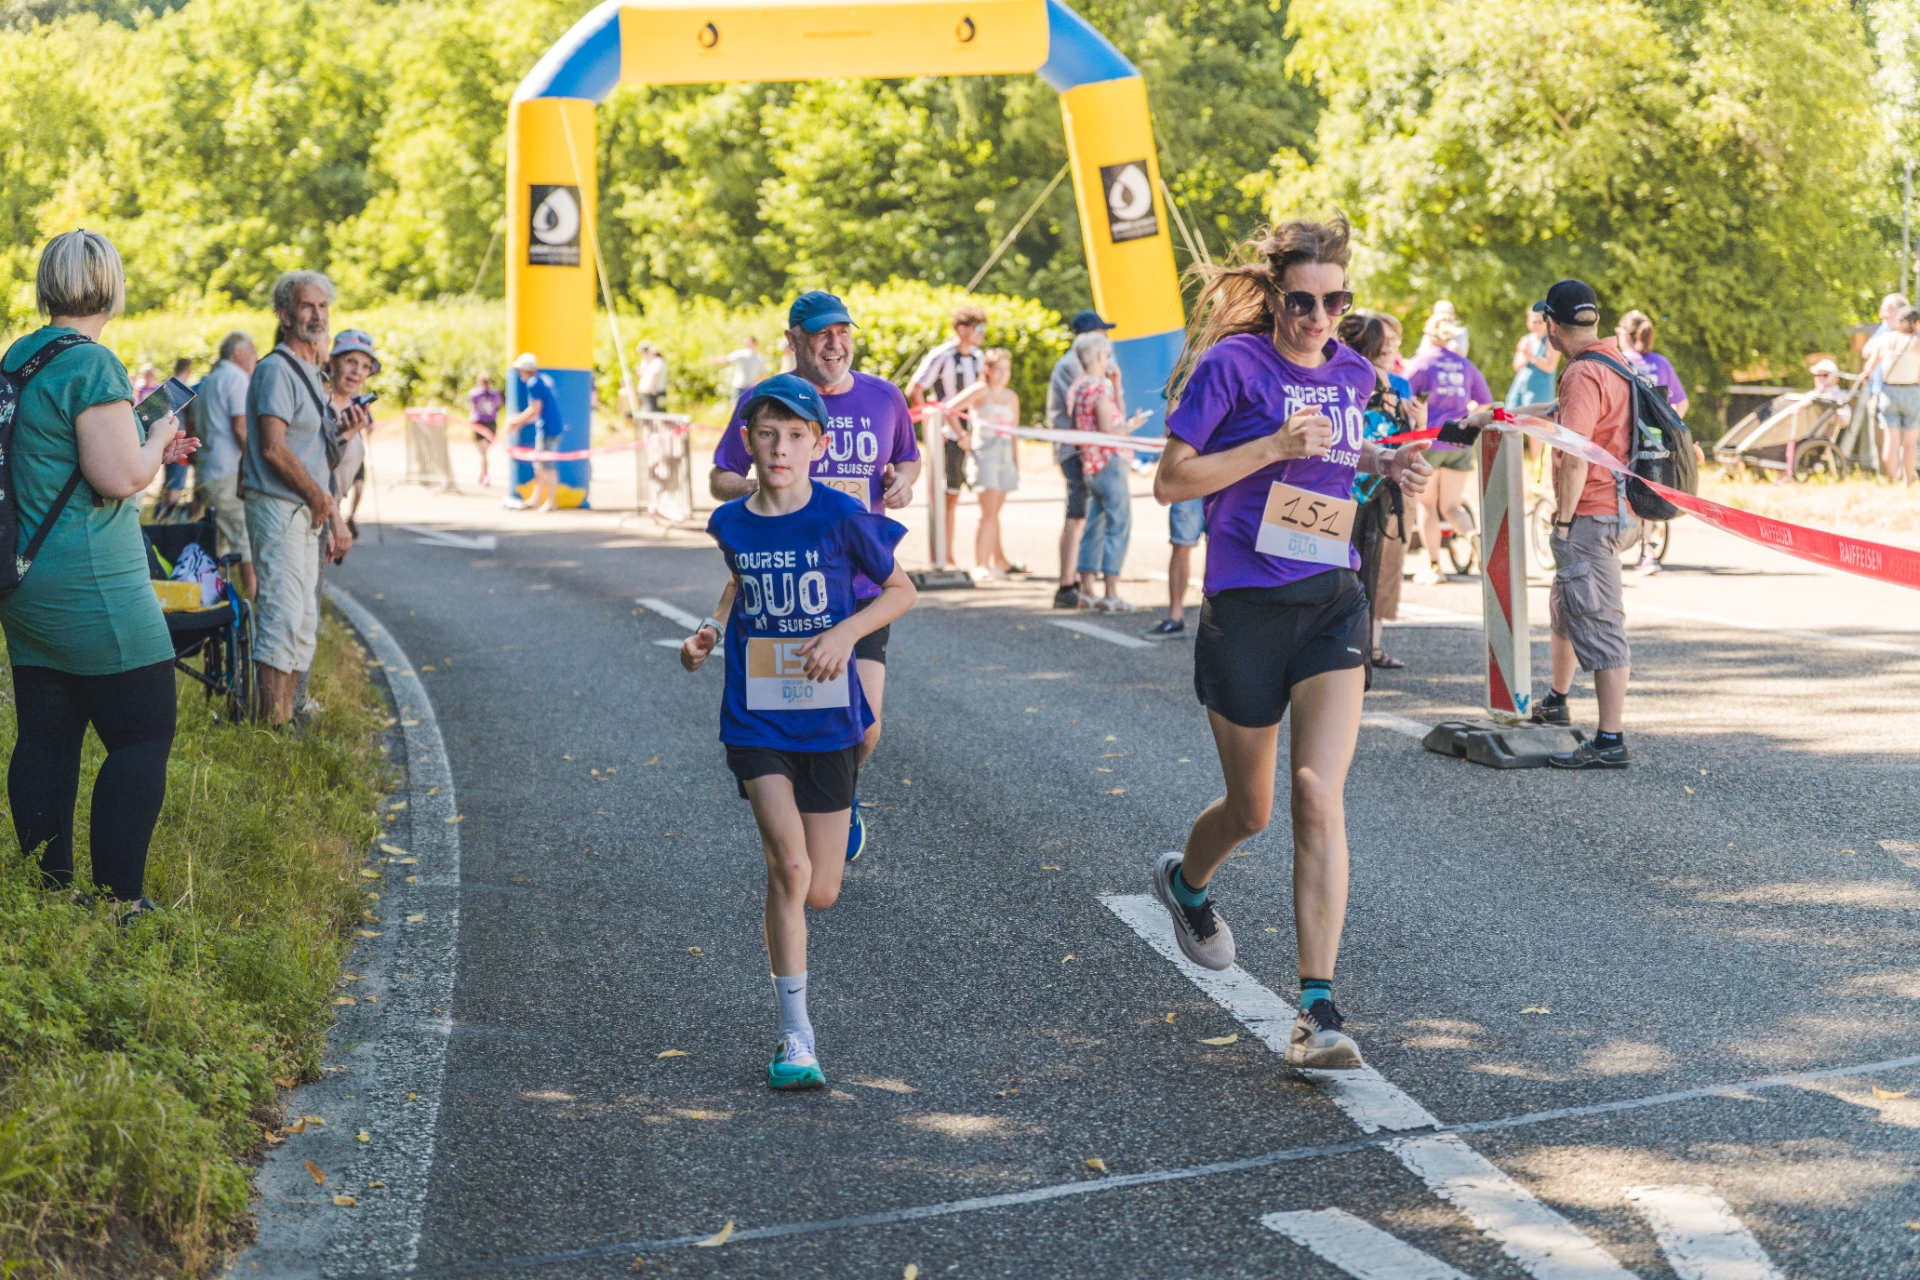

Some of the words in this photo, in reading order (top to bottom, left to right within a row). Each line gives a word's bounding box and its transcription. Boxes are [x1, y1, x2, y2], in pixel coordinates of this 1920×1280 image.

[826, 416, 854, 429] RSE
[820, 430, 878, 463] UO
[836, 463, 876, 476] SUISSE
[1281, 496, 1340, 537] 151
[1756, 519, 1793, 546] RAIFFEISEN
[1839, 541, 1882, 571] RAIFFEISEN
[740, 571, 828, 616] DUO
[778, 614, 833, 633] SUISSE
[773, 643, 809, 675] 15
[782, 685, 814, 699] DUO
